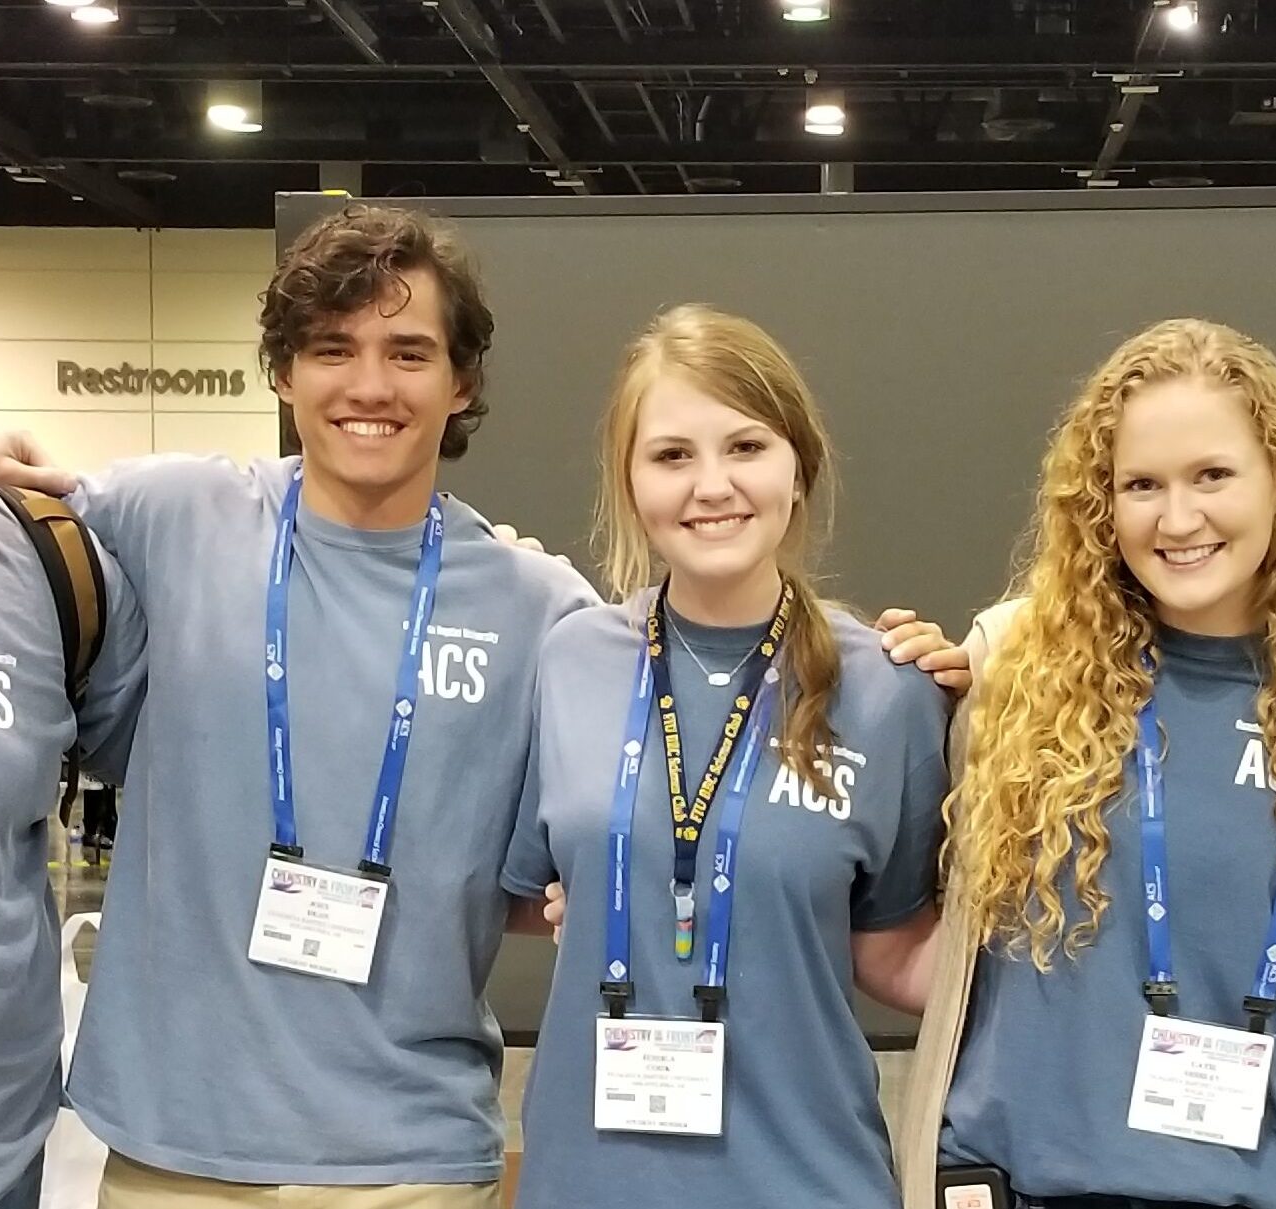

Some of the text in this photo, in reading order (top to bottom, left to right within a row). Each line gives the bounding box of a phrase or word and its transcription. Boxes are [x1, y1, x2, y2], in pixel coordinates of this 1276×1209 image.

[56, 360, 246, 397] Restrooms
[725, 712, 743, 738] Club
[768, 756, 855, 820] ACS
